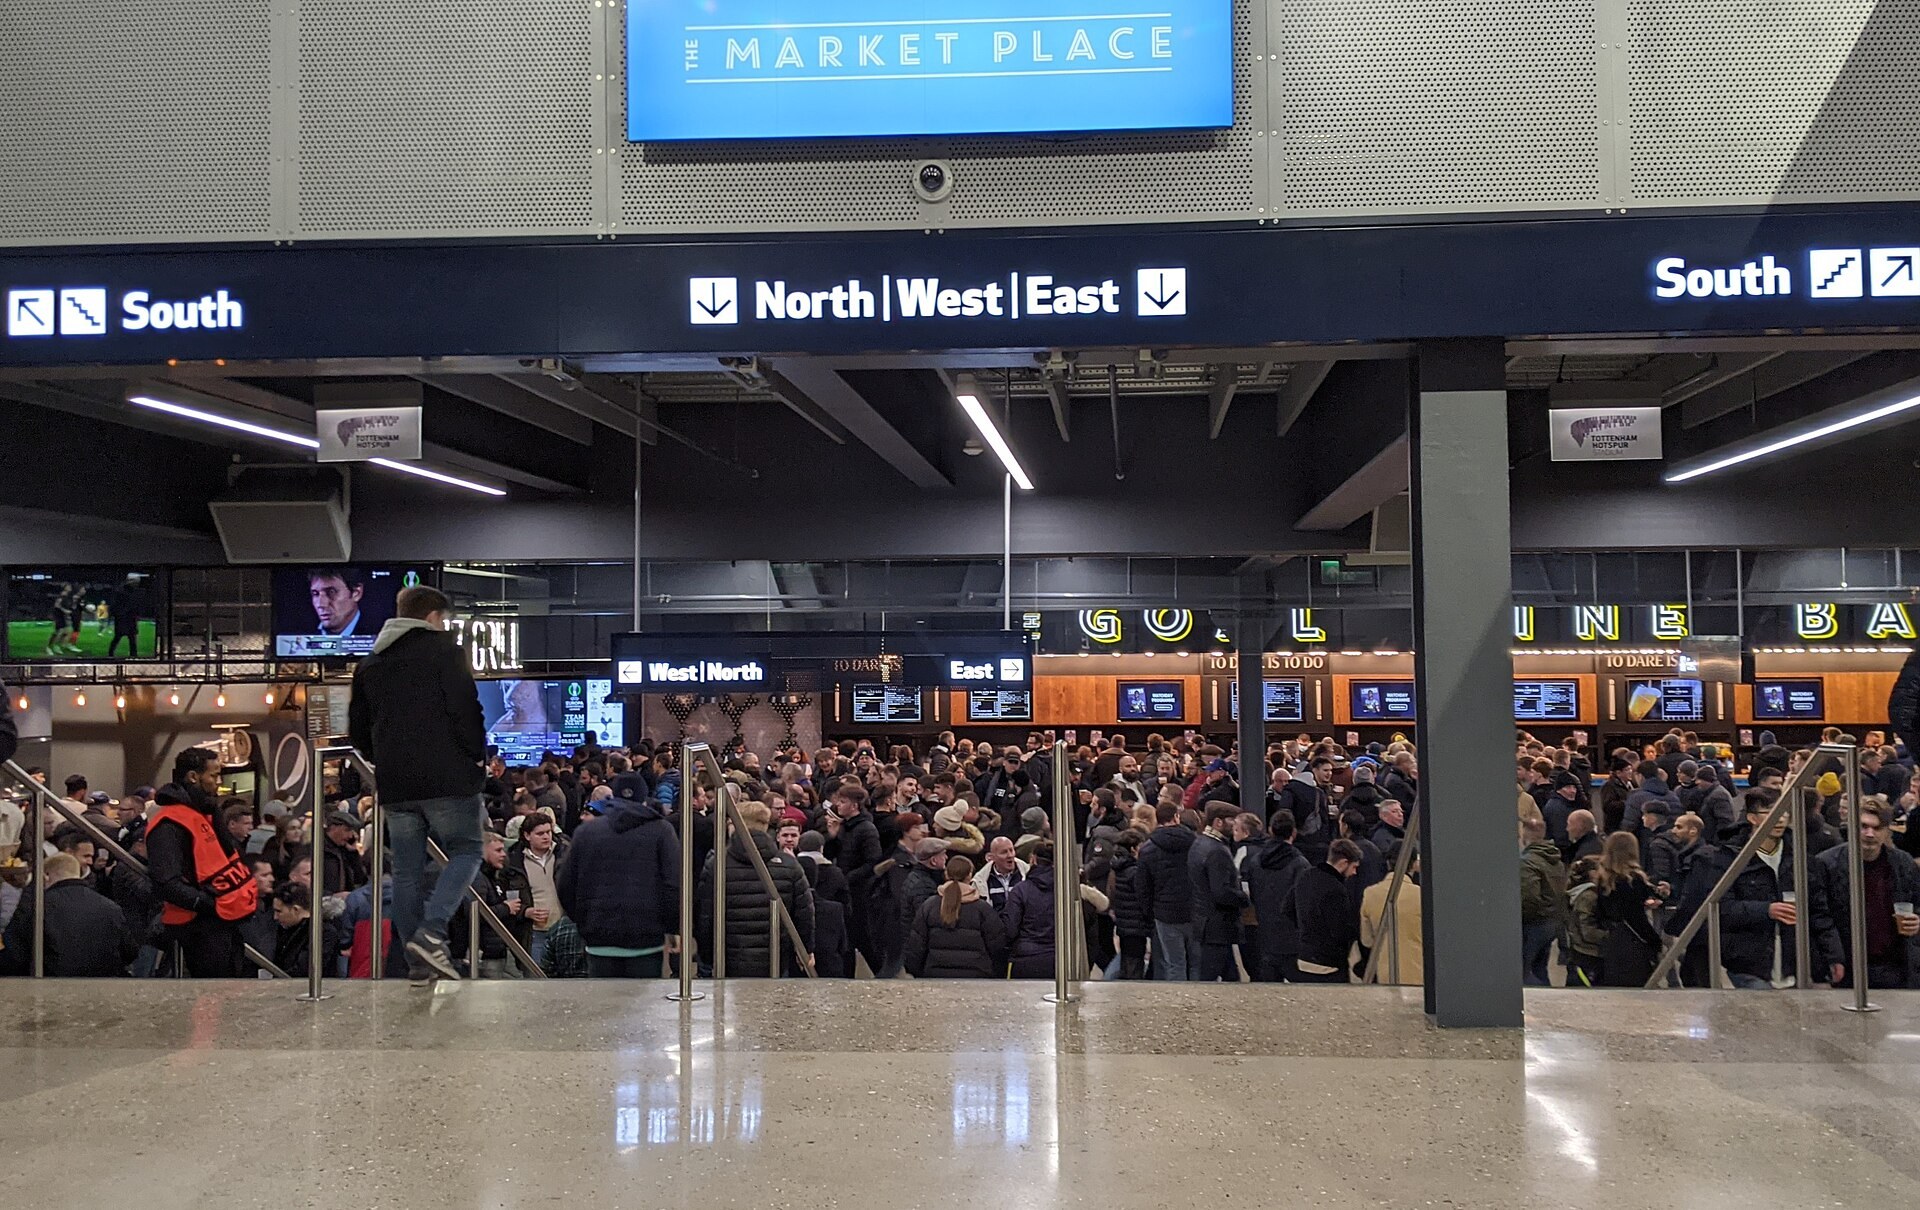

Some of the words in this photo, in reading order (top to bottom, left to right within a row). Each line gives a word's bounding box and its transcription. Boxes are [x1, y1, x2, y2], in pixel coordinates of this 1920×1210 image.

[684, 38, 699, 71] THE
[726, 34, 959, 69] MARKET
[993, 26, 1173, 63] PLACE
[1655, 256, 1792, 298] South
[755, 279, 875, 319] North
[896, 278, 1003, 317] West
[1026, 275, 1120, 315] East
[122, 290, 243, 330] South
[355, 434, 400, 442] TOTTENHAM
[1590, 434, 1638, 442] TOTTENHAM
[1592, 441, 1629, 449] HOTSPUR
[949, 660, 994, 680] East
[1208, 656, 1228, 669] TO
[1267, 656, 1281, 669] IS
[1283, 656, 1301, 669] TO
[1303, 656, 1324, 669] DO
[1604, 654, 1624, 668] TO
[1626, 654, 1665, 668] DARE
[1666, 654, 1679, 668] IS
[648, 661, 698, 682] West
[707, 662, 763, 681] North
